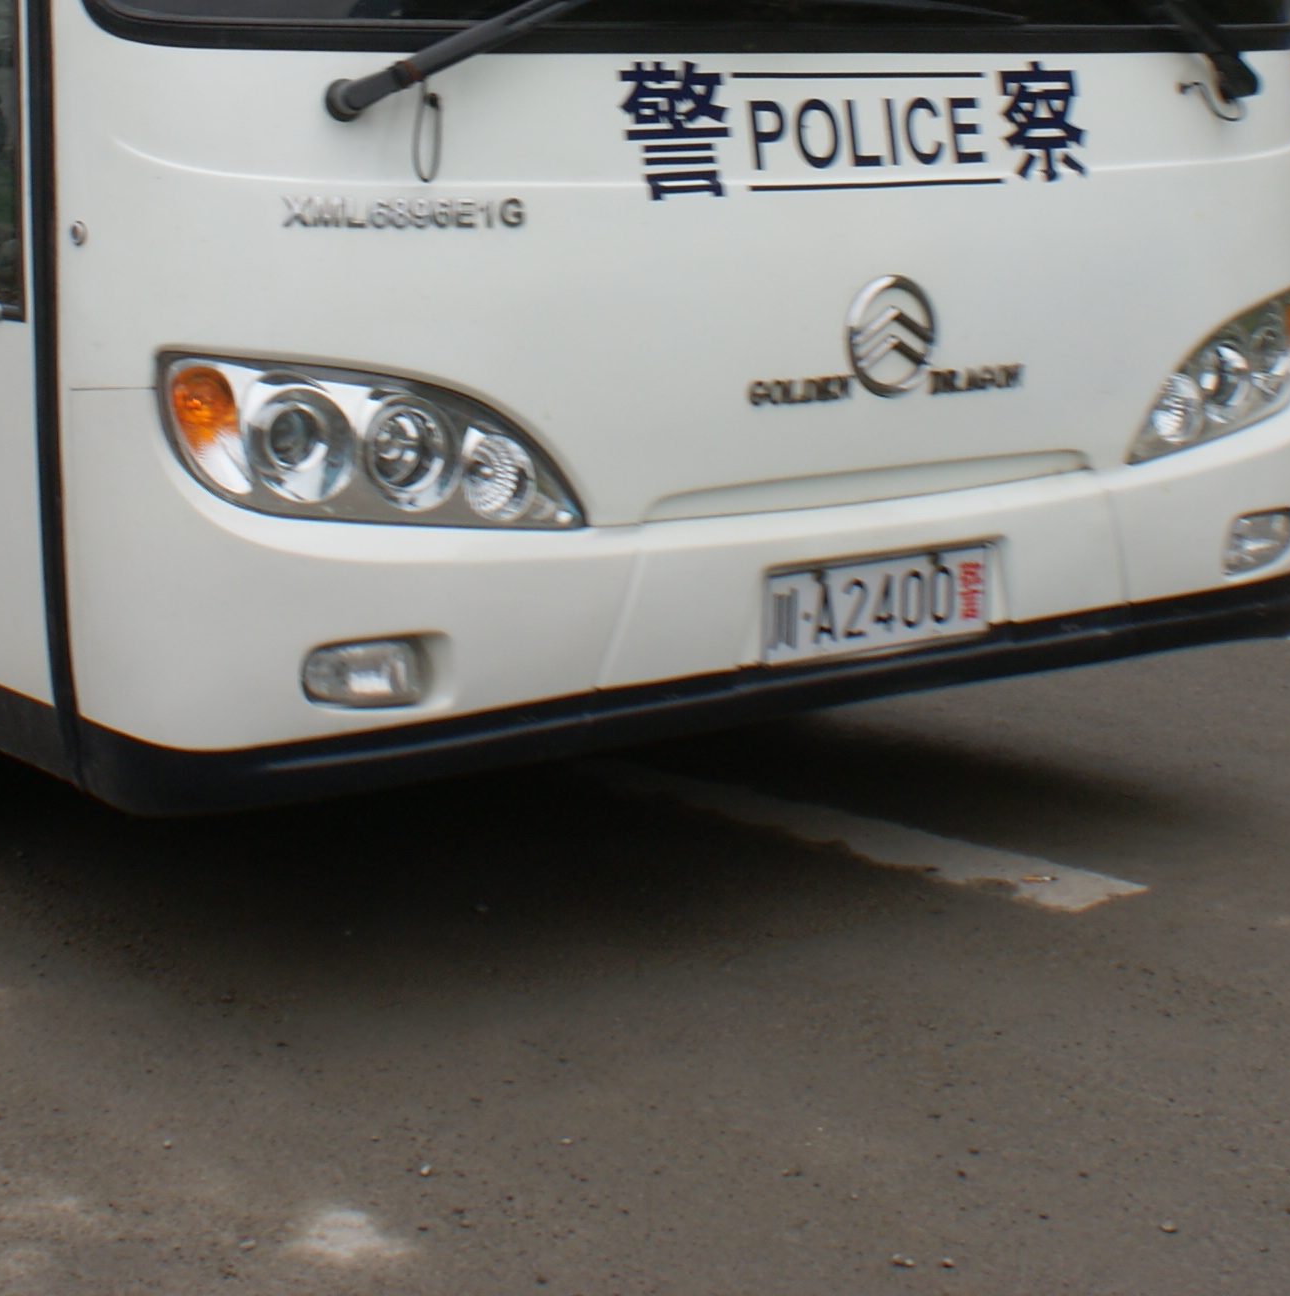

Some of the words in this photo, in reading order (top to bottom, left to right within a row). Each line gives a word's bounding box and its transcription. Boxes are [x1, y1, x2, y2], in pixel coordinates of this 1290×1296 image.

[616, 59, 731, 202] 警
[746, 95, 987, 171] POLICE
[995, 60, 1087, 183] 察
